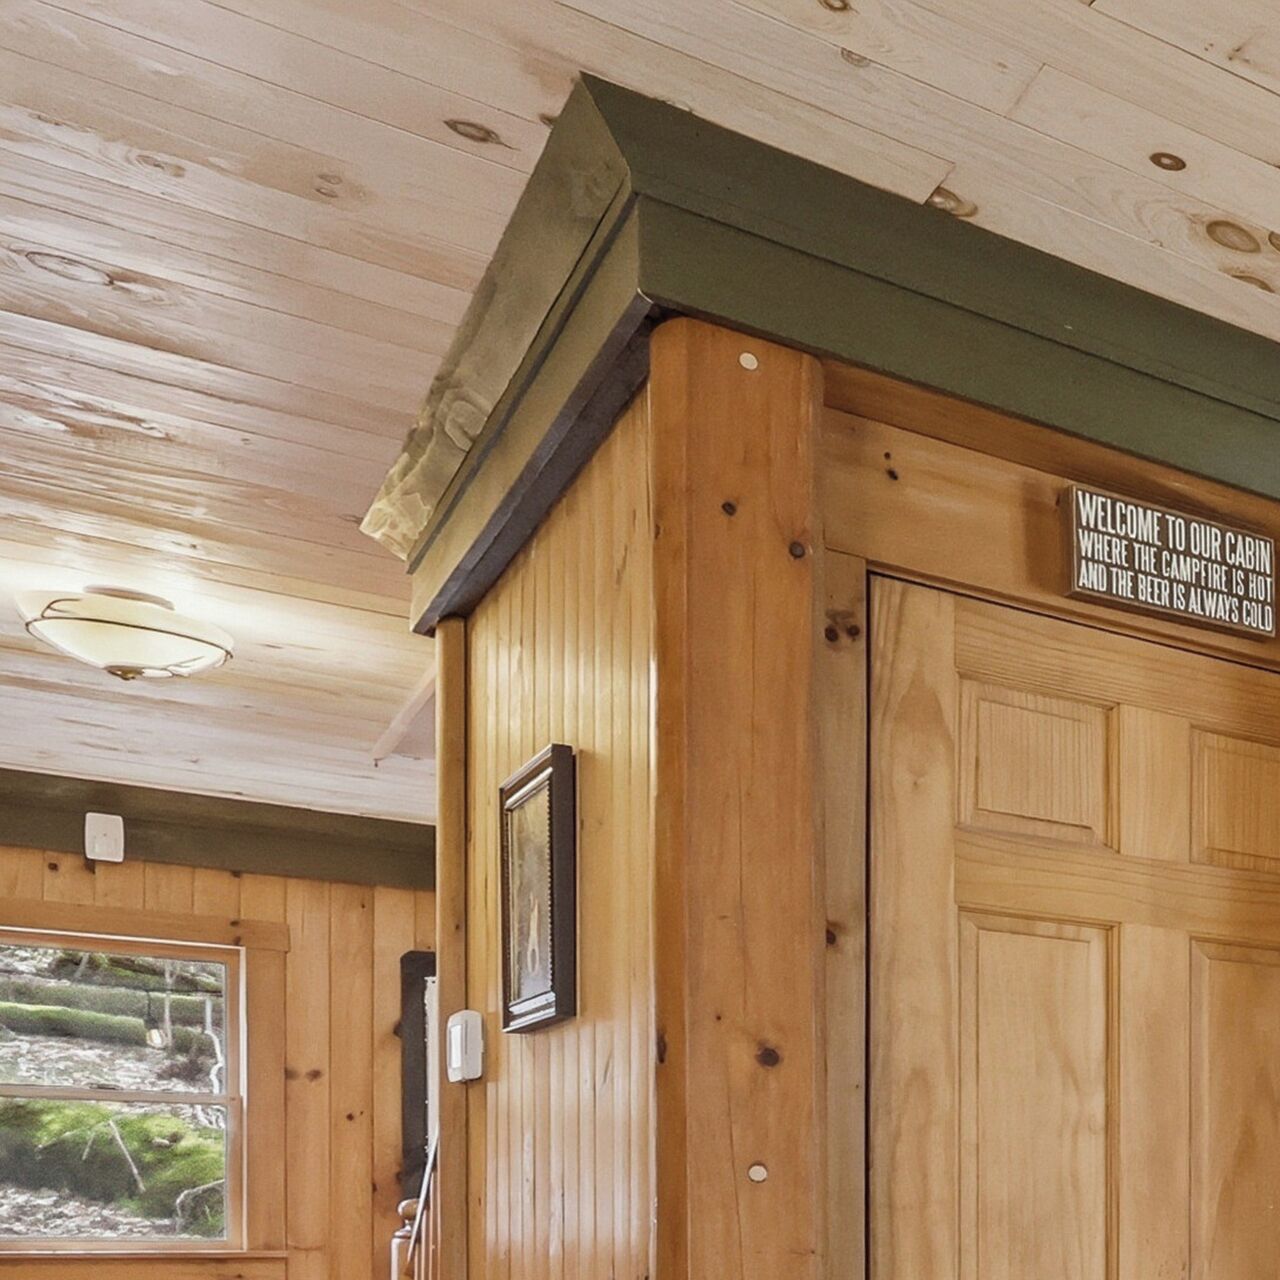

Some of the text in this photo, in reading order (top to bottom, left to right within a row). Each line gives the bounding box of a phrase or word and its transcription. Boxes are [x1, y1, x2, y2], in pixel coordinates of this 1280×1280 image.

[1078, 490, 1271, 574] WELCOME TO OUR CABIN
[1079, 529, 1272, 602] WHERE THE CAMPFIRE IS HOT
[1079, 560, 1272, 631] AND THE BEER IS ALWAYS COLD
